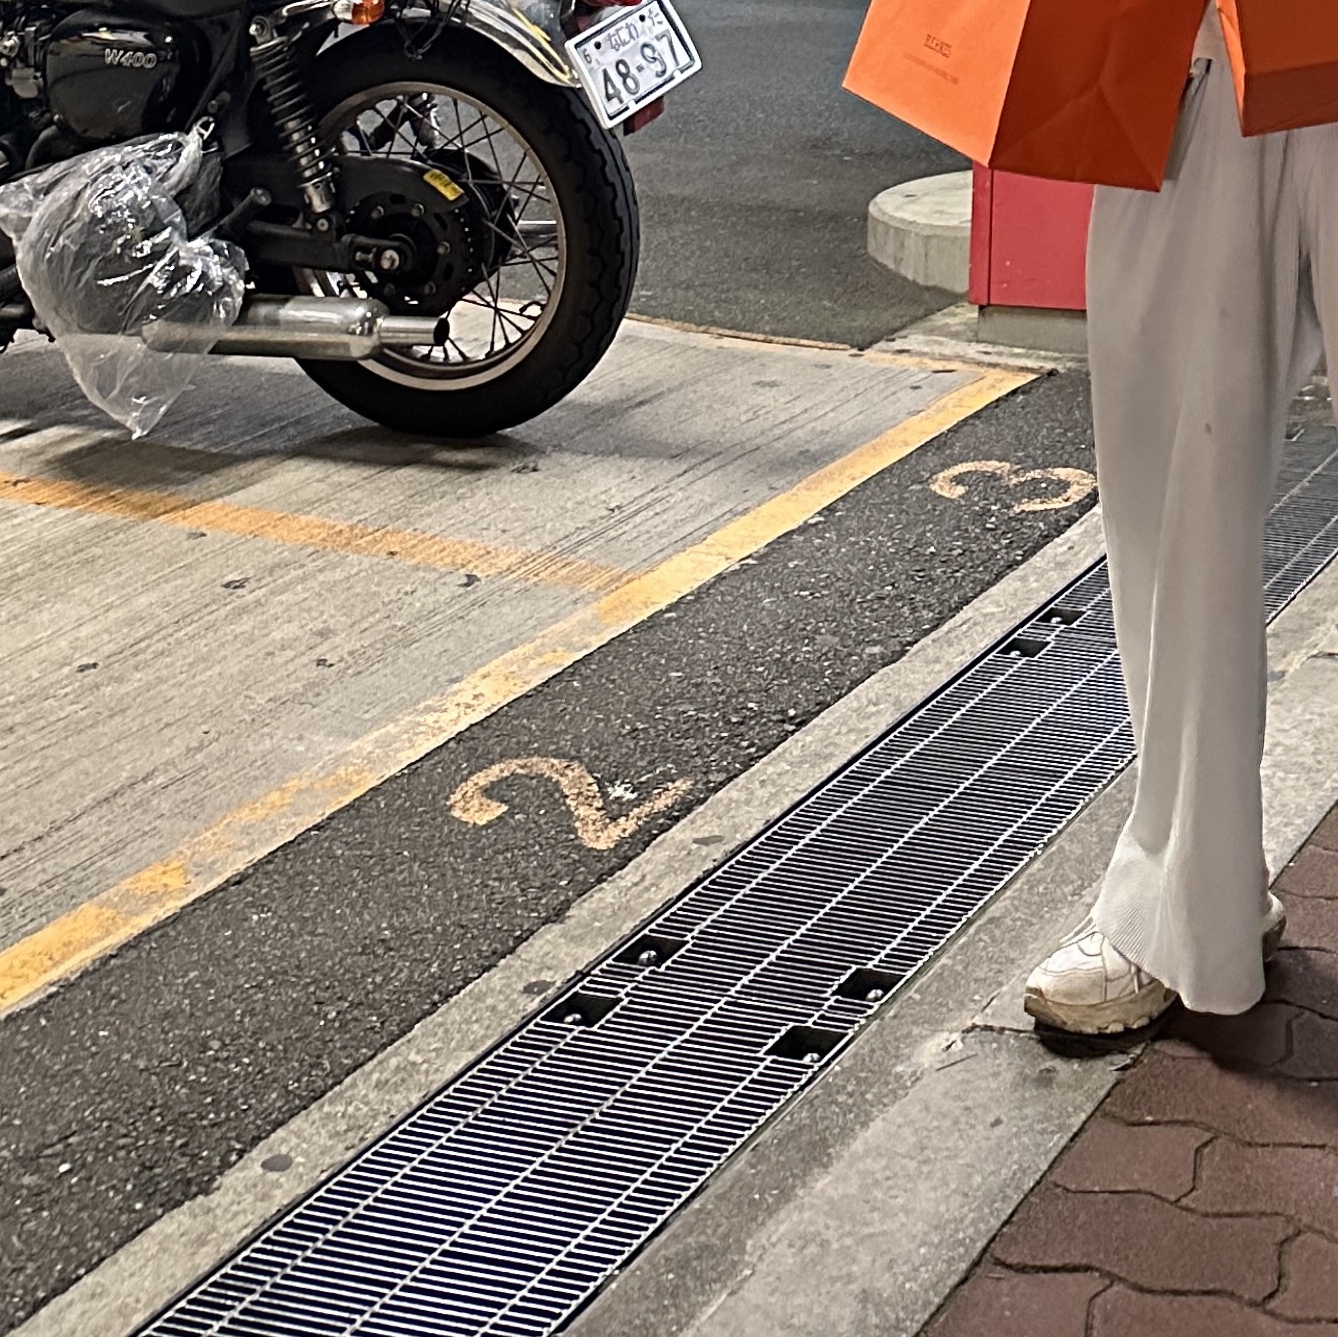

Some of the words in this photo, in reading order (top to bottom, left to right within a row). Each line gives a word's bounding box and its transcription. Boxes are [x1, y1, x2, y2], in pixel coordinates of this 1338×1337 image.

[105, 48, 157, 69] W400
[602, 28, 680, 105] 48-97
[446, 753, 693, 851] 2
